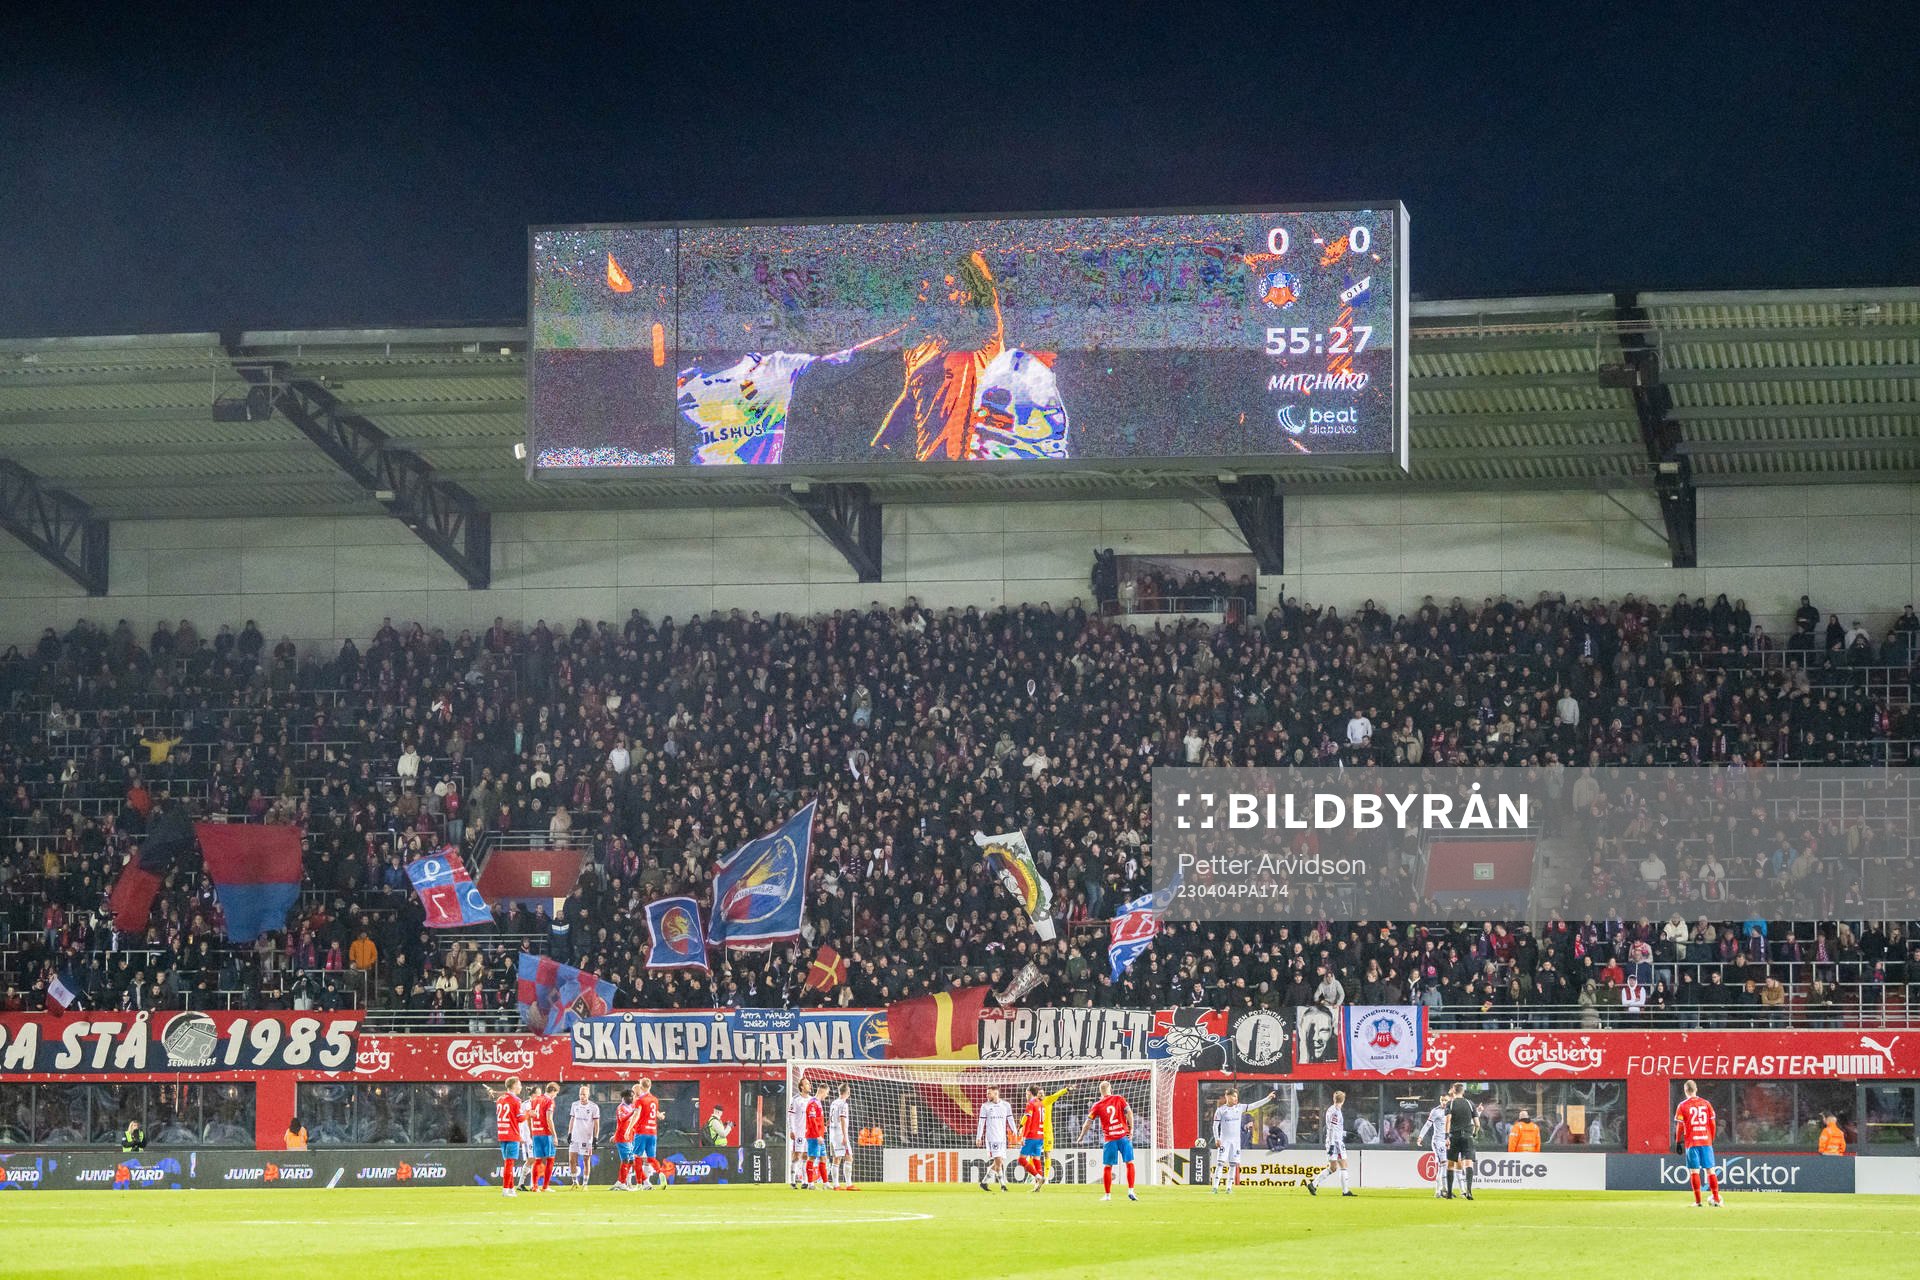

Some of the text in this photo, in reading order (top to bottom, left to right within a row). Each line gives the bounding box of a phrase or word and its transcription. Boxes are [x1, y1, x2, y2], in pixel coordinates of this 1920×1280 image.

[1267, 227, 1289, 255] 0
[1349, 226, 1371, 252] 0
[1346, 282, 1363, 298] OIF
[1266, 326, 1373, 355] 55:27
[1310, 407, 1358, 424] beat
[1233, 1014, 1248, 1029] HIGH
[0, 1021, 38, 1070] A
[55, 1010, 149, 1070] STÅ
[223, 1017, 358, 1067] 1985
[982, 1009, 1150, 1060] MPANIET
[447, 1039, 535, 1071] Carlsberg
[1508, 1036, 1603, 1069] Carlsberg
[1626, 1054, 1884, 1076] FOREVER FASTER PUMA
[496, 1103, 510, 1122] 22
[649, 1102, 657, 1119] 3
[1106, 1105, 1119, 1124] 2
[1689, 1105, 1708, 1125] 25
[6, 1171, 40, 1182] YARD
[76, 1170, 164, 1181] JUMP YARD
[224, 1168, 314, 1180] JUMP YARD
[357, 1167, 447, 1179] JUMP YARD
[753, 1154, 762, 1182] SELECT
[1195, 1155, 1204, 1182] SELECT
